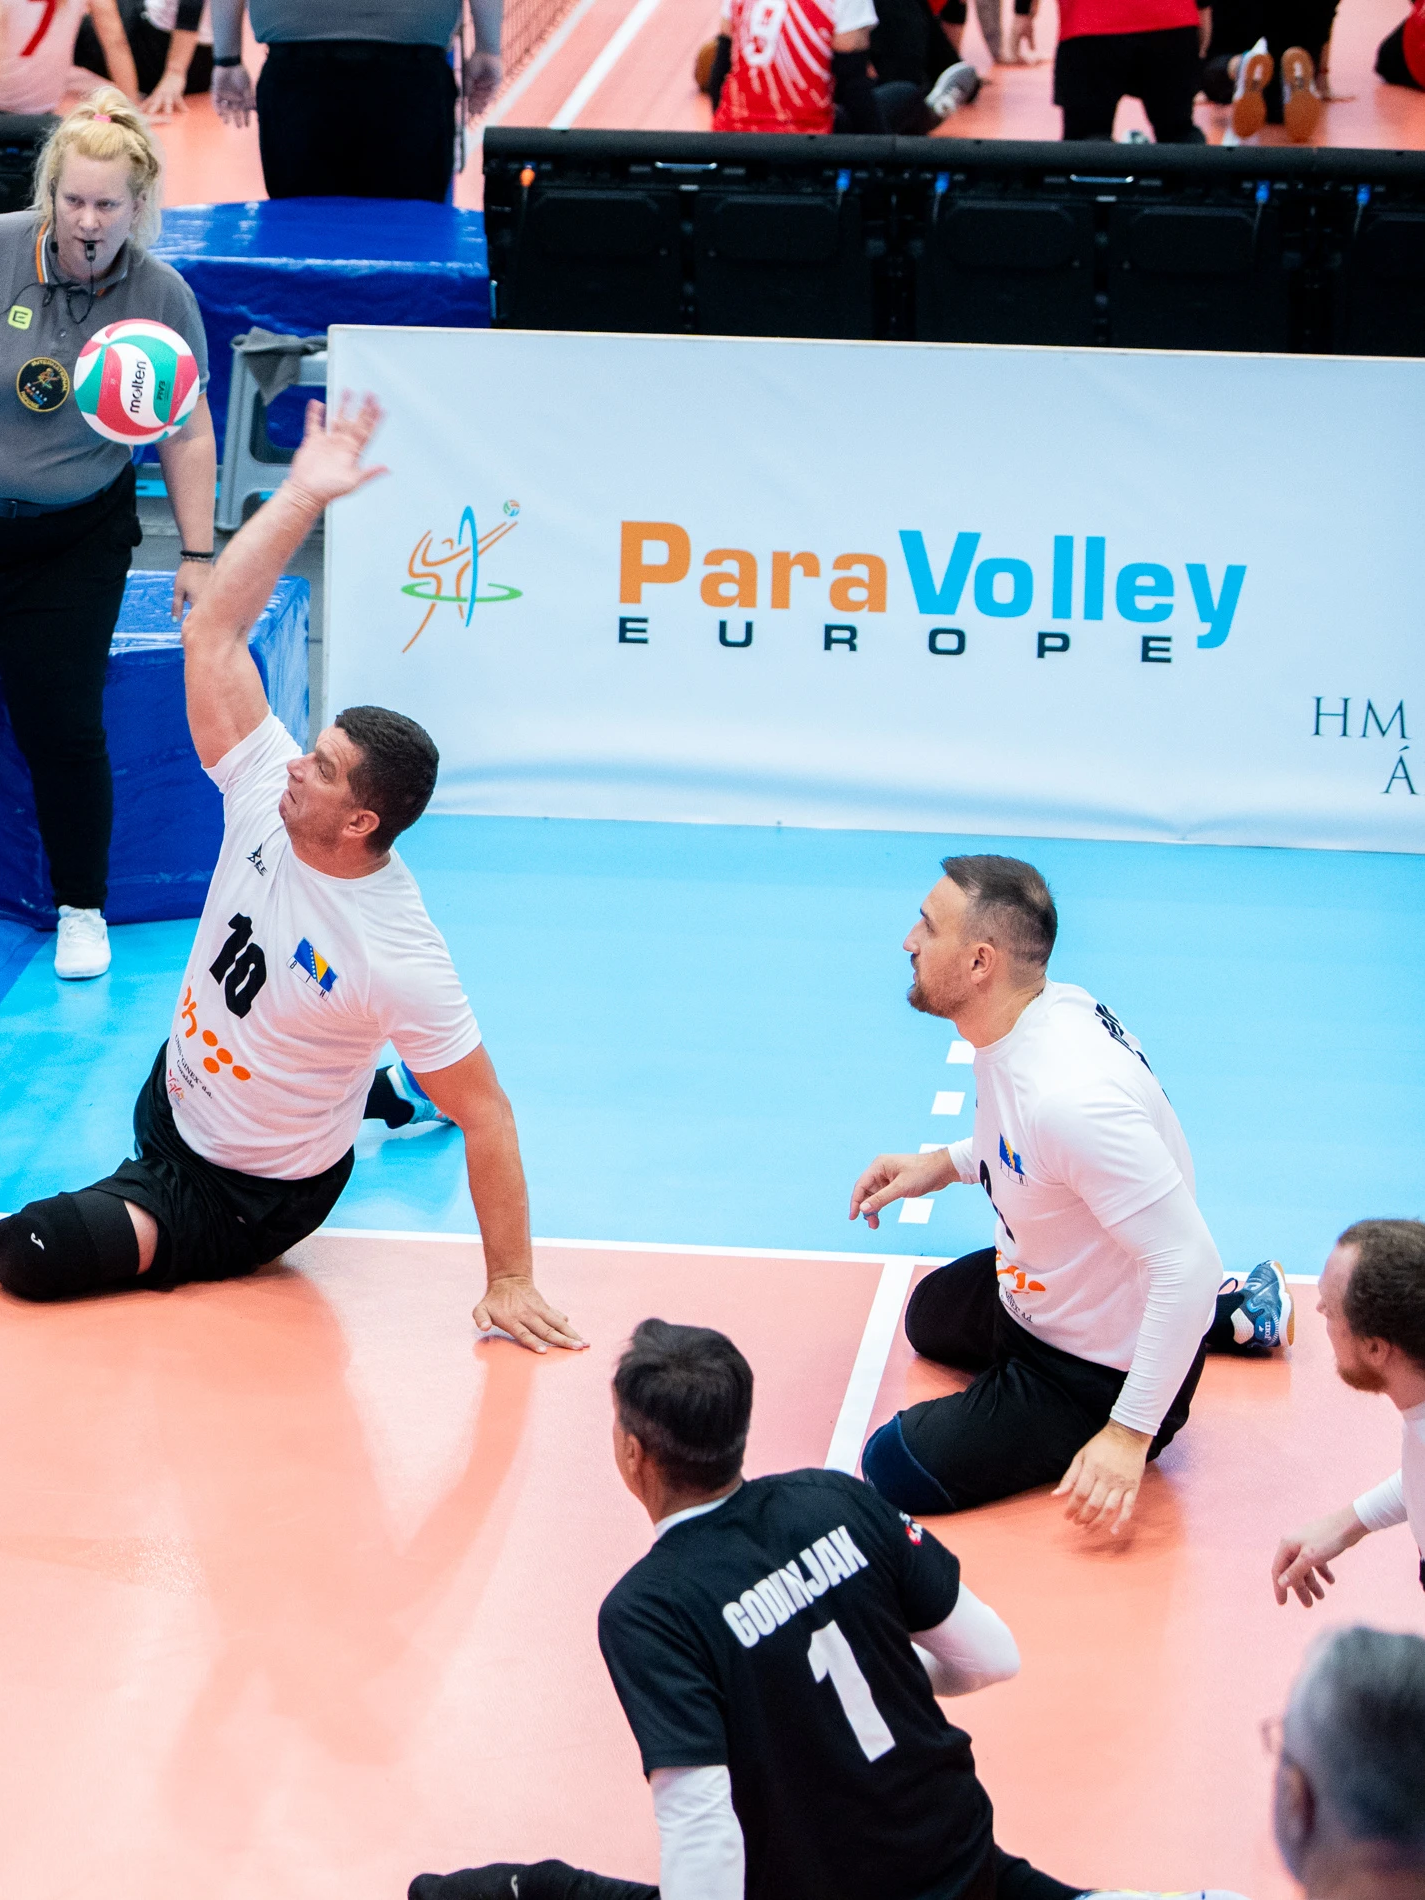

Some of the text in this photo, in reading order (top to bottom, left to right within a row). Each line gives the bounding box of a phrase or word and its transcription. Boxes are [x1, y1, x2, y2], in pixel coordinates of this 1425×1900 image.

[20, 0, 56, 57] 7
[130, 360, 147, 414] molten
[618, 520, 1247, 650] ParaVolley
[617, 616, 1174, 664] EUROPE
[1311, 695, 1411, 739] HM
[208, 911, 267, 1019] 10
[722, 1525, 869, 1649] GODINJAK
[807, 1619, 896, 1763] 1
